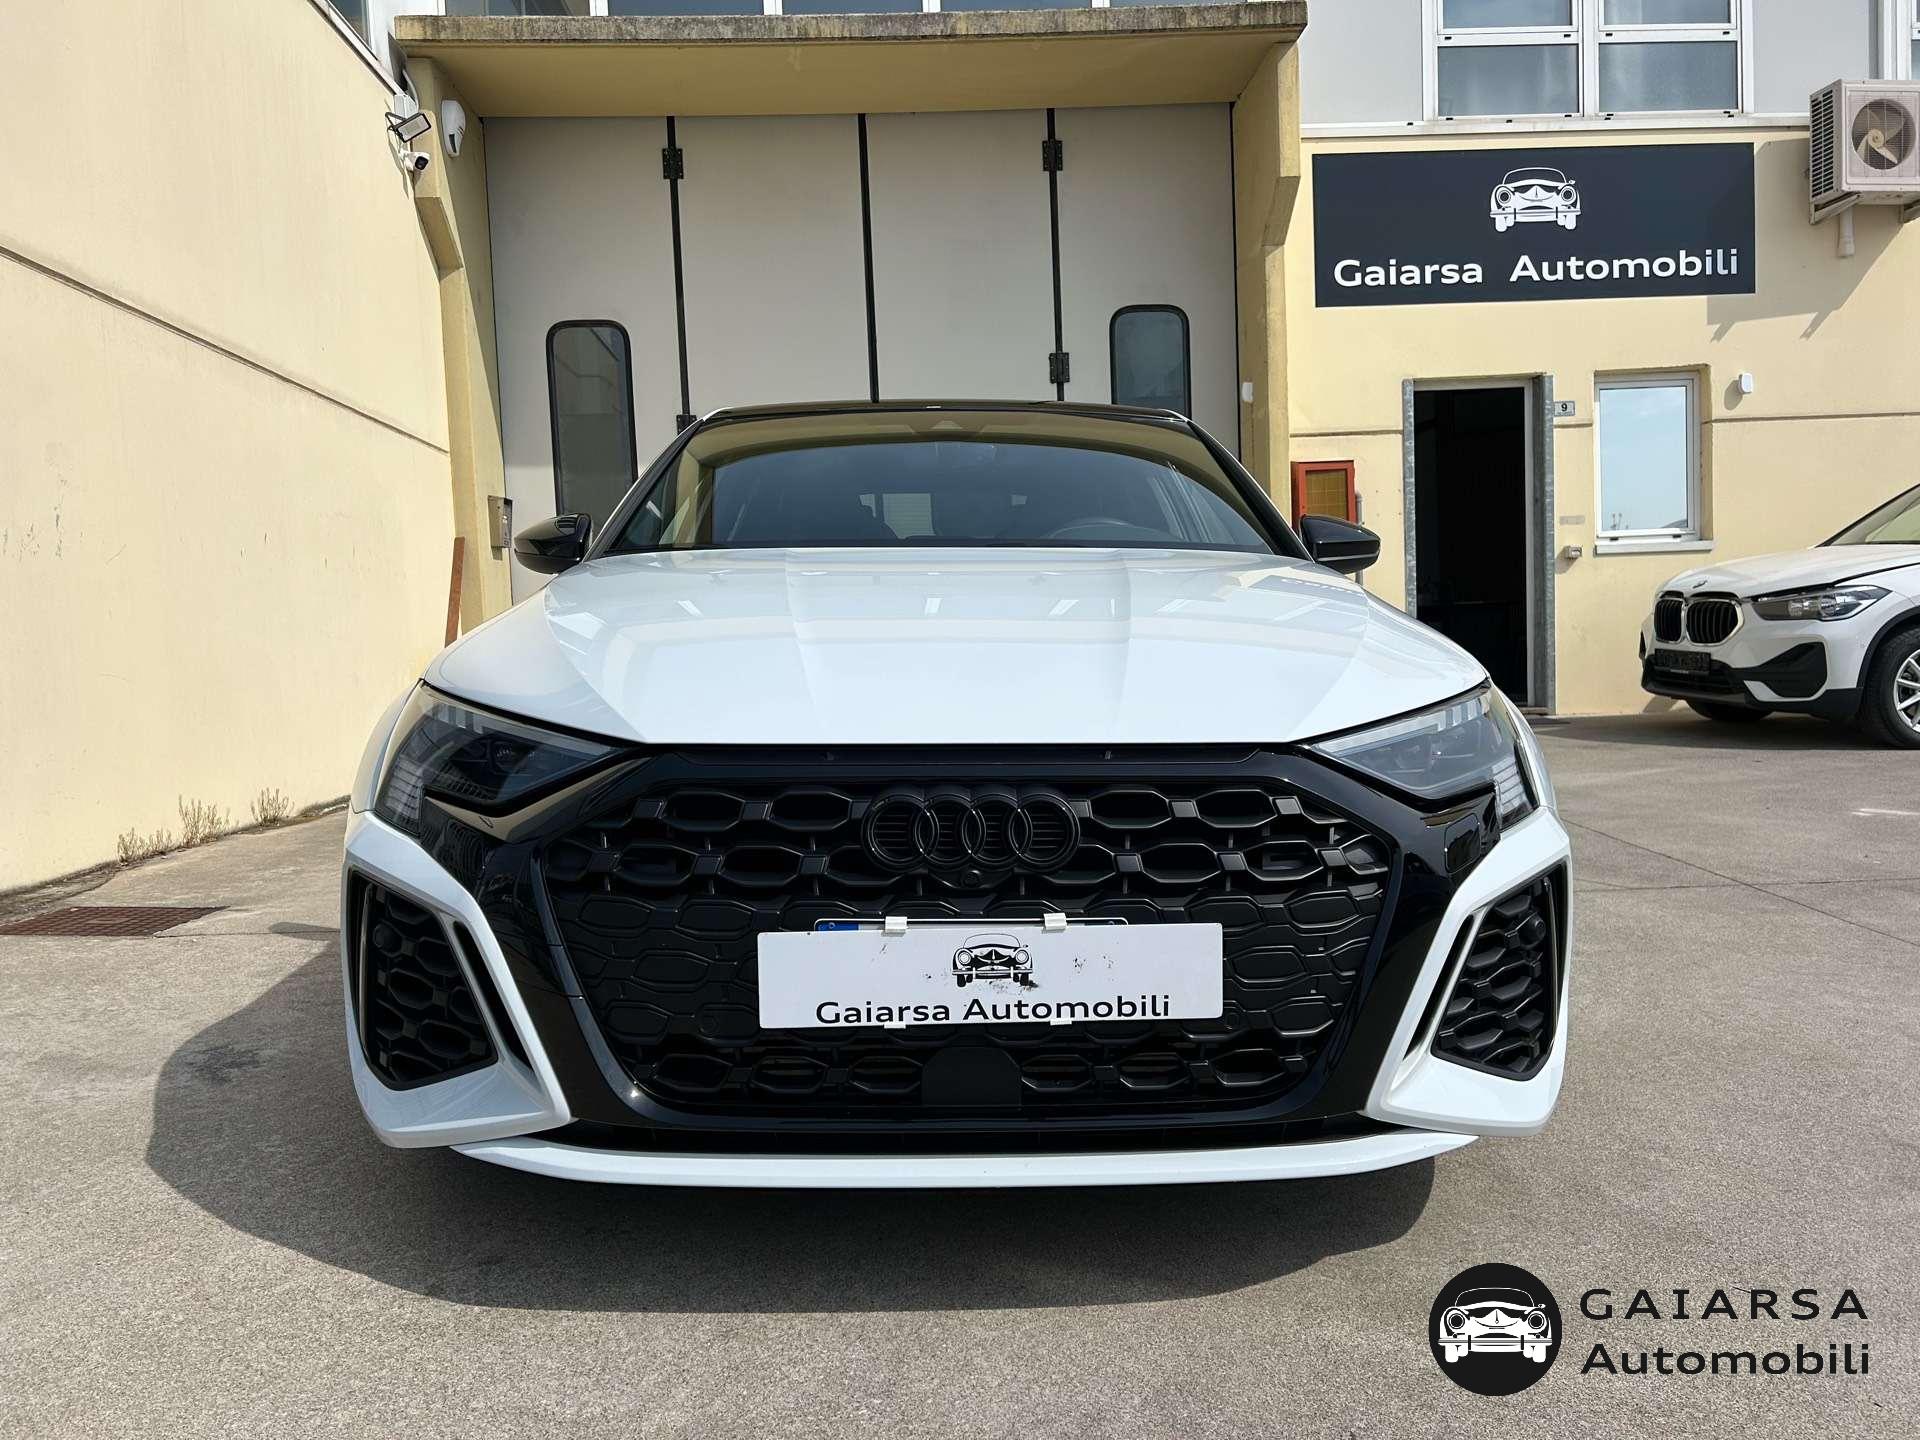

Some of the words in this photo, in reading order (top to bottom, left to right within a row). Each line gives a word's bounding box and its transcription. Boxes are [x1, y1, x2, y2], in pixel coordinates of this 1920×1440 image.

[1333, 258, 1483, 287] Gaiarsa
[1509, 248, 1738, 282] Automobili
[1561, 403, 1568, 412] 9
[816, 1000, 951, 1024] Gaiarsa
[962, 994, 1170, 1021] Automobili
